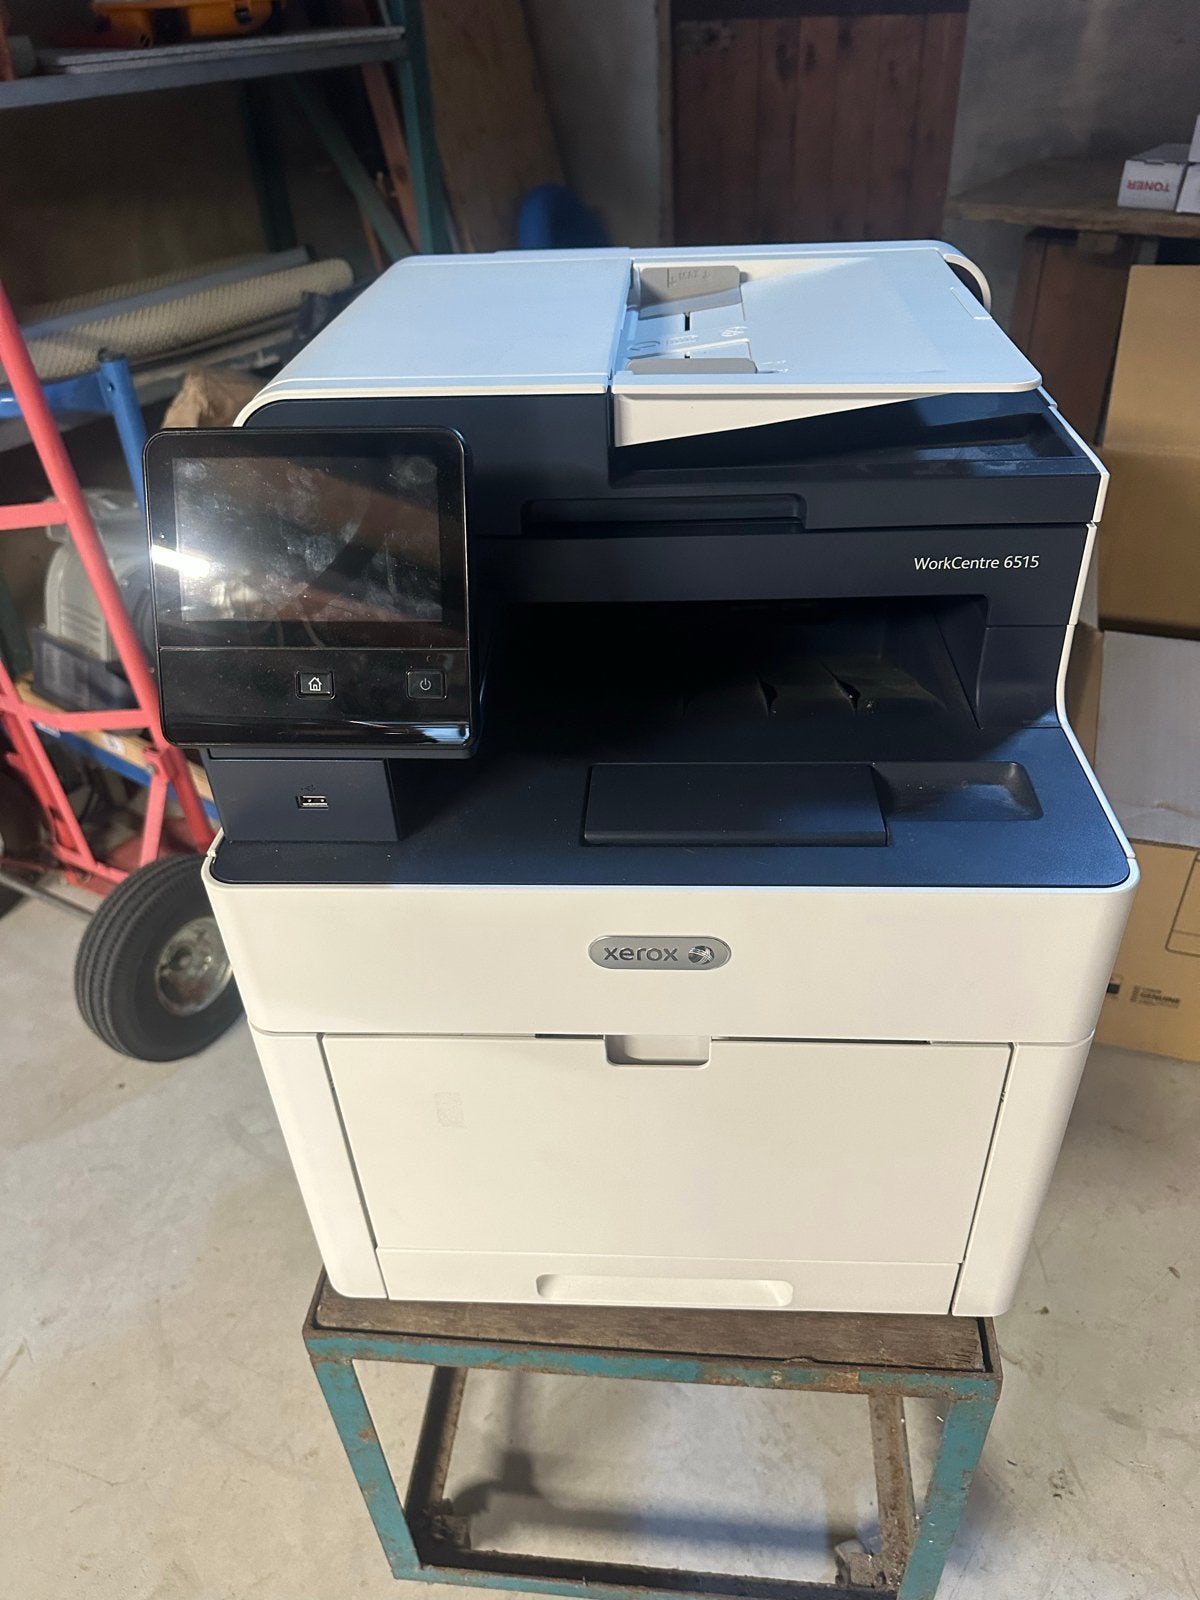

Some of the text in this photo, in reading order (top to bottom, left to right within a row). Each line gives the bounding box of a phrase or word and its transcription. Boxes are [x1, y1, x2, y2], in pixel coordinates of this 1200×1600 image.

[1127, 180, 1170, 192] TONER
[914, 556, 1040, 570] WorkCentre 6515
[603, 947, 679, 962] xerox
